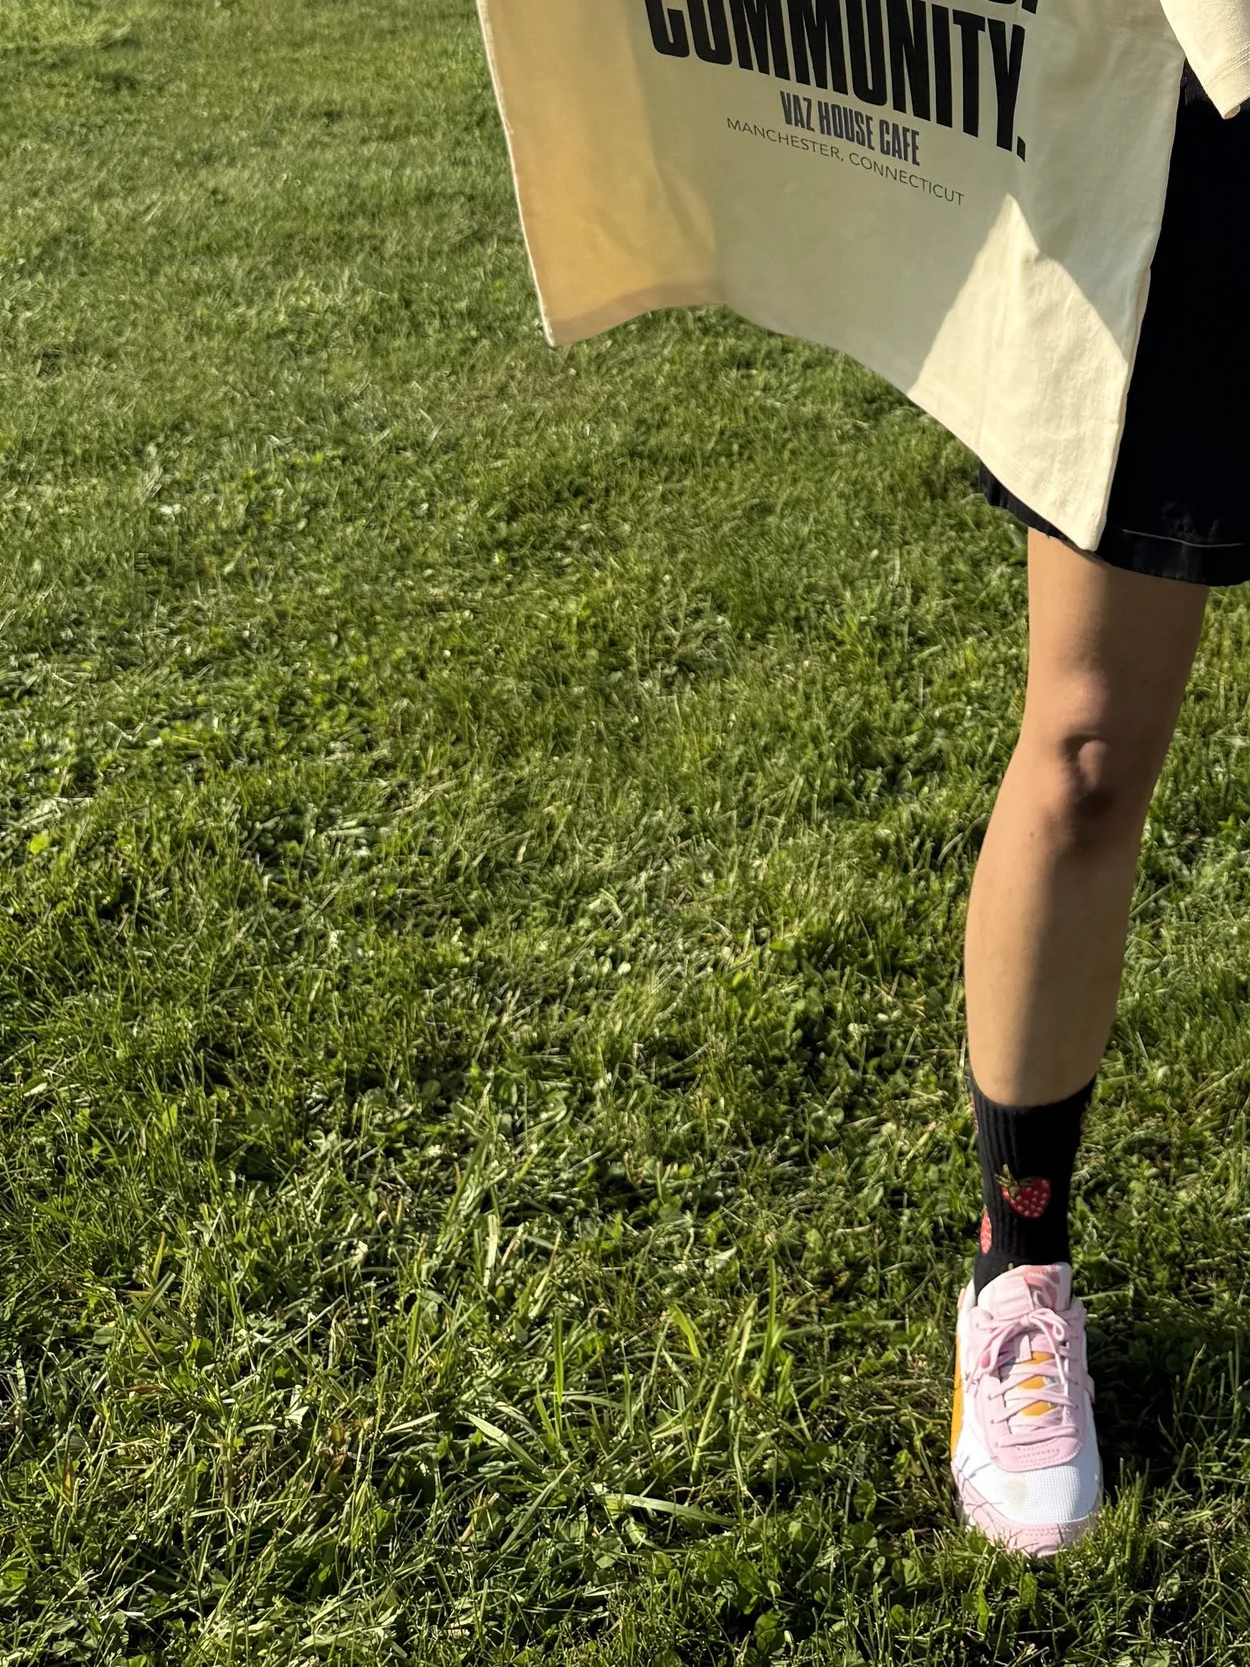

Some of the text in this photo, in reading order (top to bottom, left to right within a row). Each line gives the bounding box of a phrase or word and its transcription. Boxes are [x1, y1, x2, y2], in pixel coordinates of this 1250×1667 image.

[726, 117, 965, 205] MANCHESTER, CONNECTICUT
[780, 90, 920, 166] VAZ HOUSE CAFE
